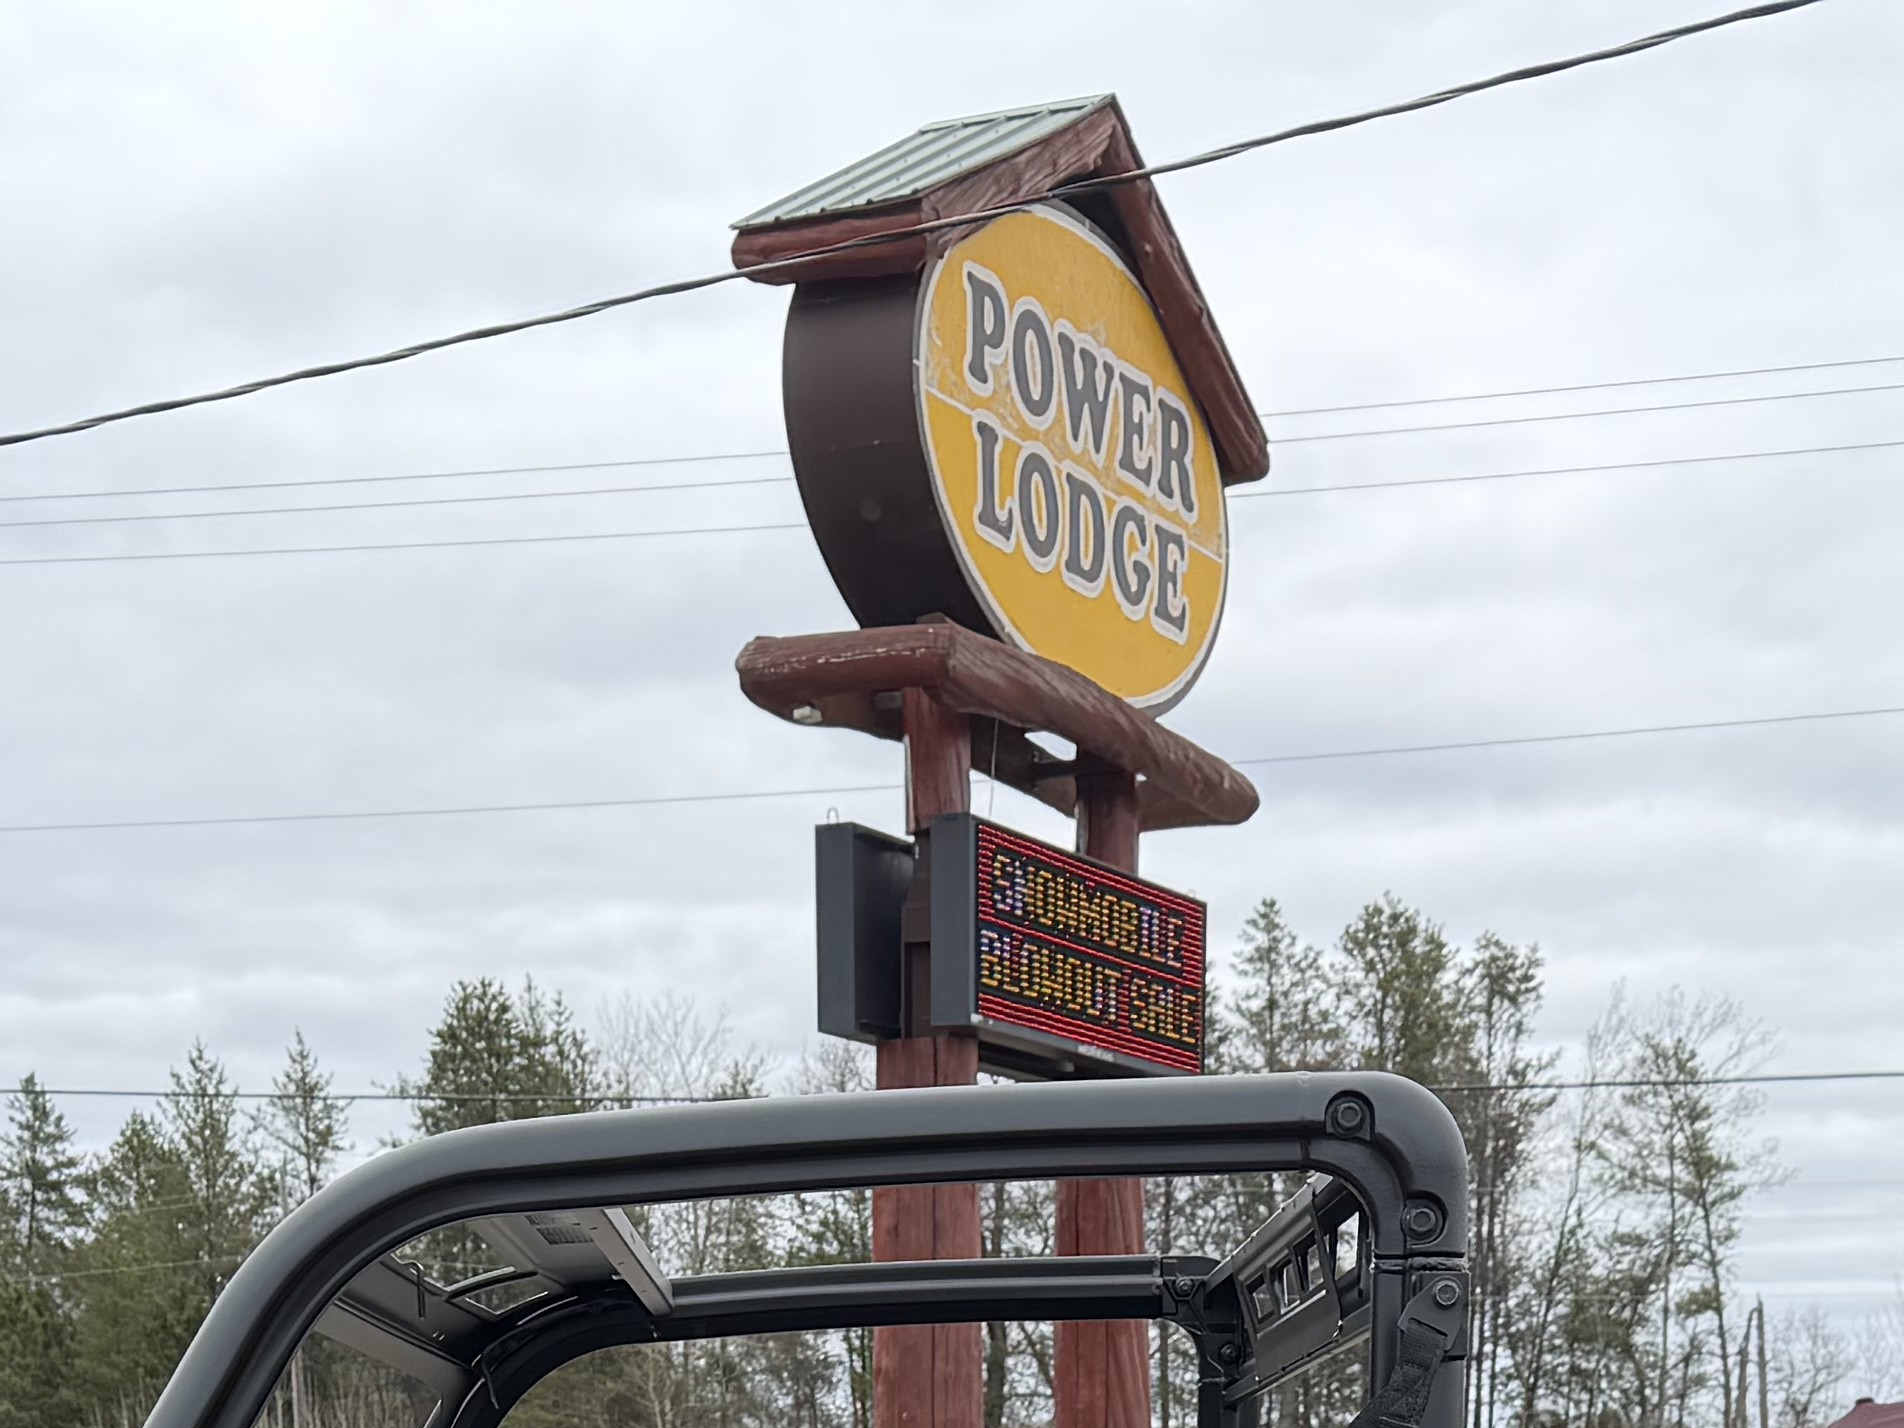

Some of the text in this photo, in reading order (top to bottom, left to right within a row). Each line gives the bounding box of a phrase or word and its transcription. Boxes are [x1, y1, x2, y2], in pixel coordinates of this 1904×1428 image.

[966, 269, 1196, 515] POWER
[976, 420, 1189, 634] LODGE
[980, 928, 1197, 1044] BLOWOUT SALE
[993, 853, 1183, 969] SNOWMOBILE
